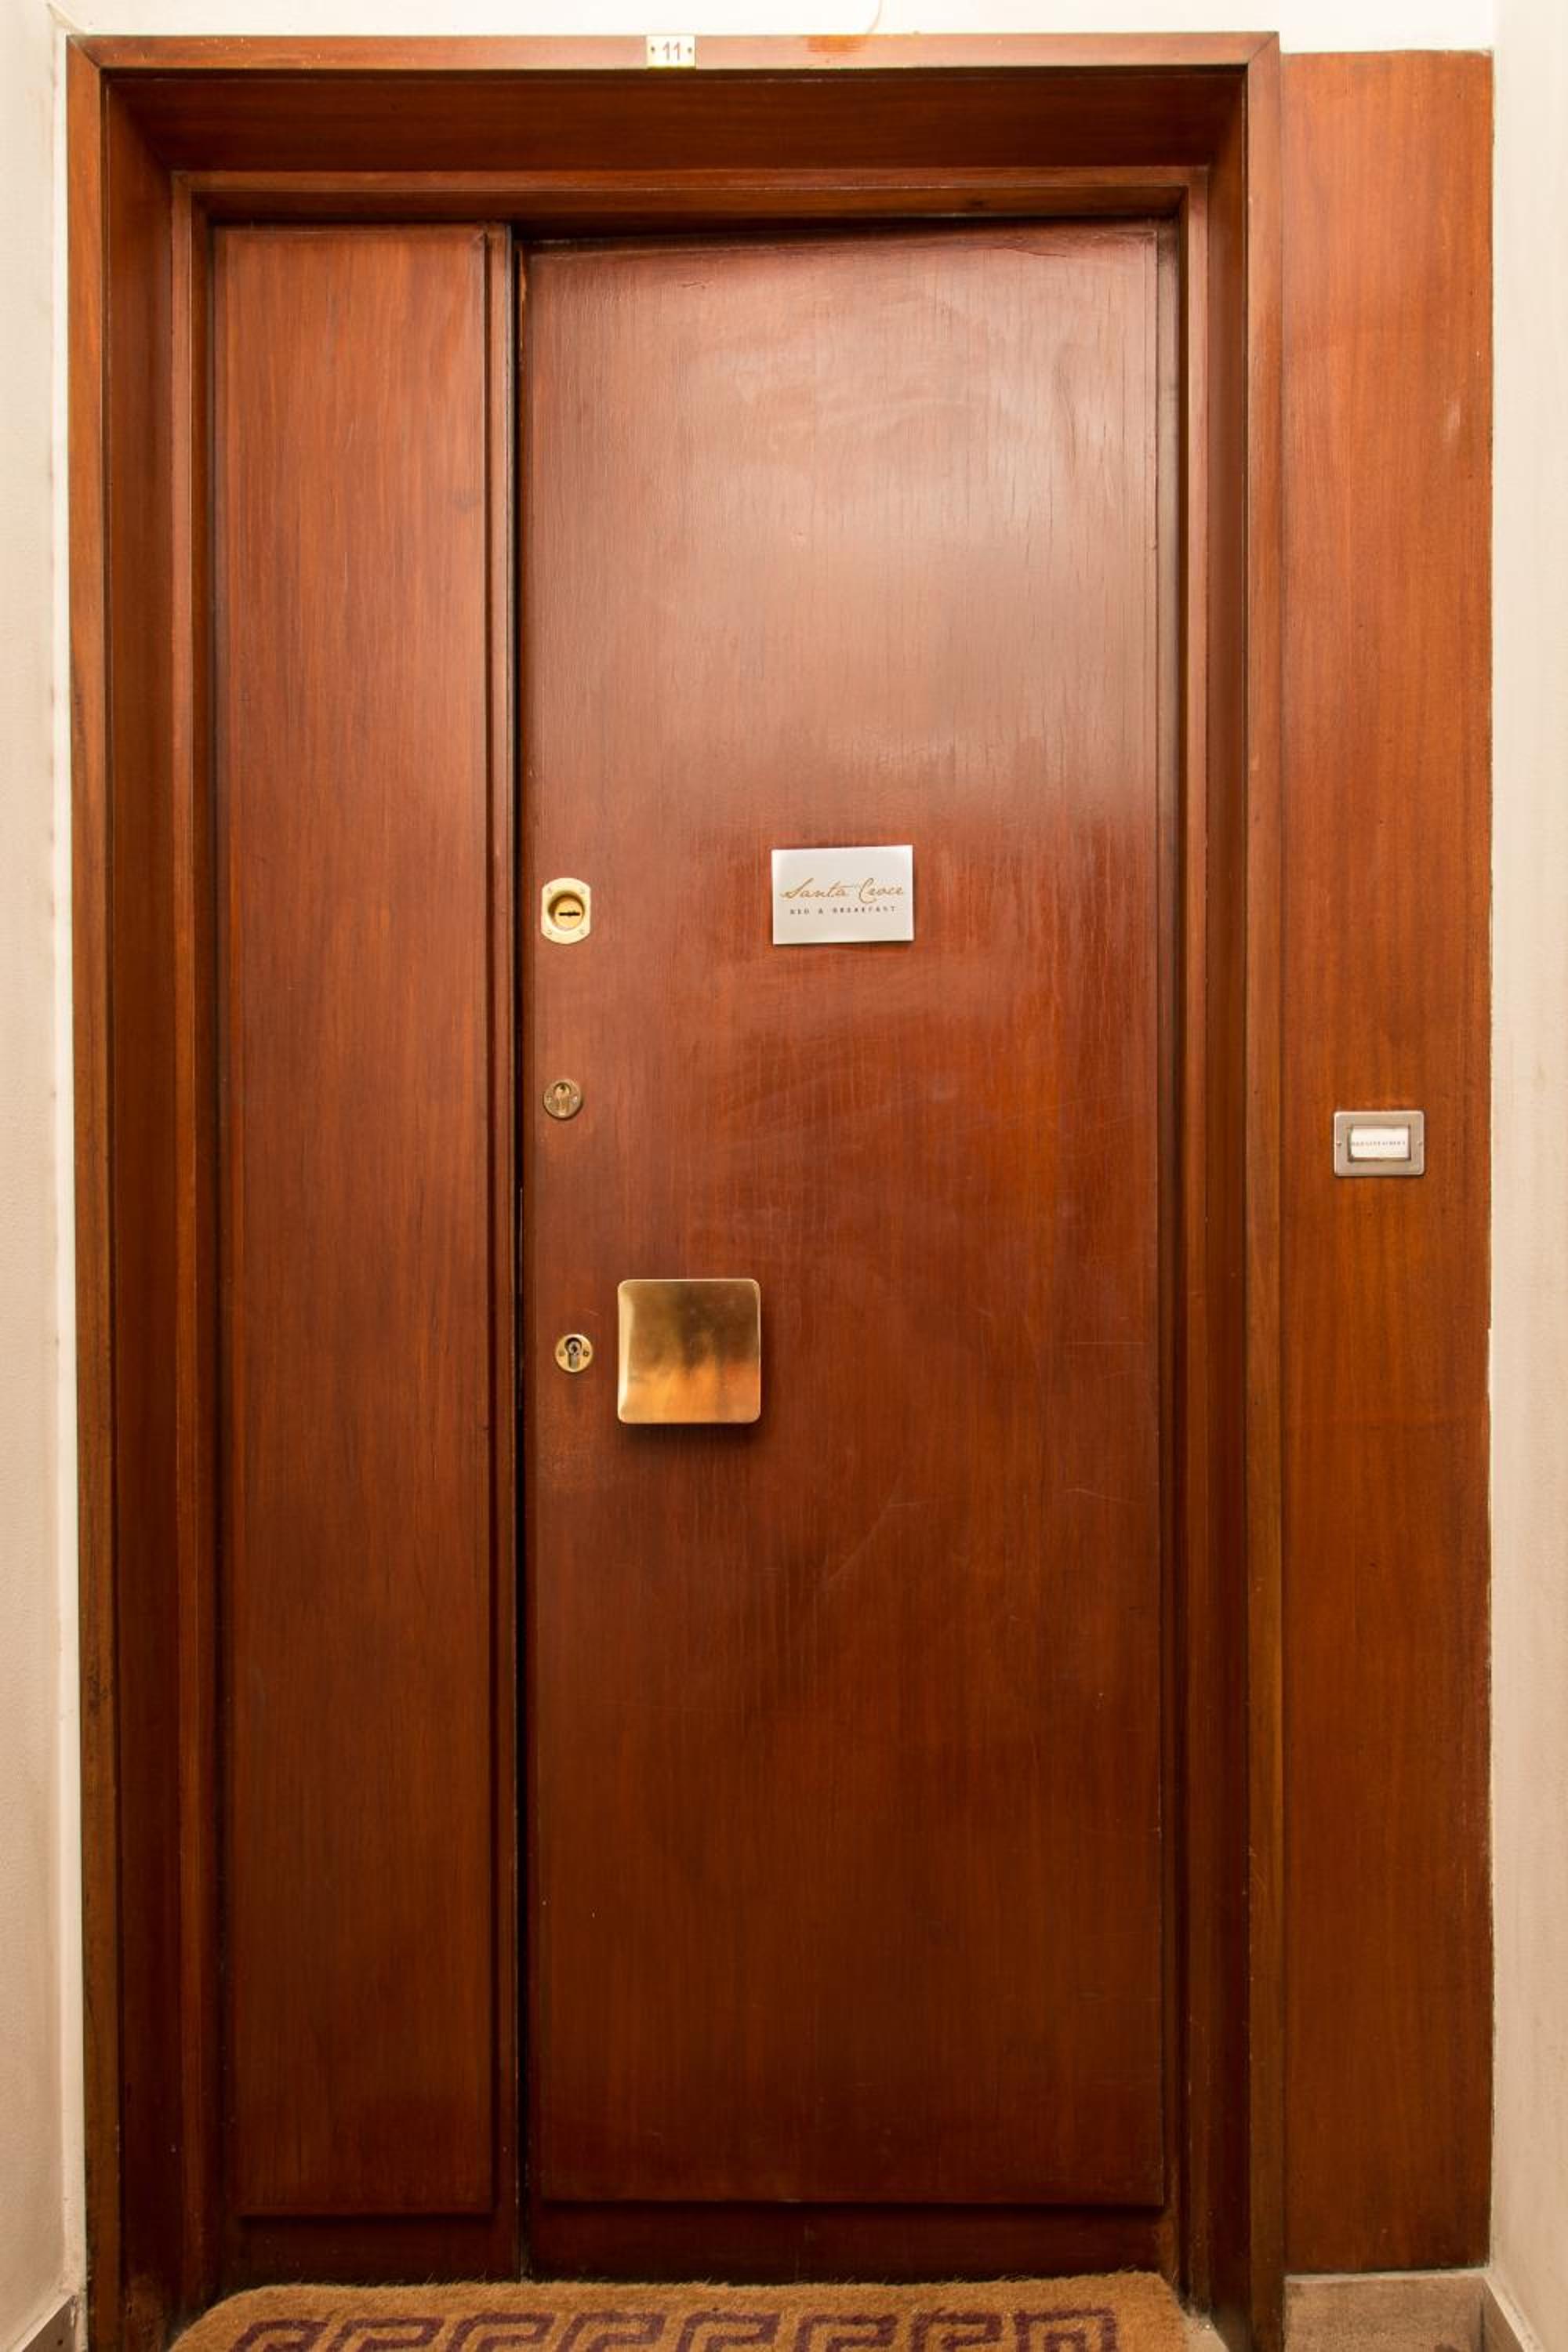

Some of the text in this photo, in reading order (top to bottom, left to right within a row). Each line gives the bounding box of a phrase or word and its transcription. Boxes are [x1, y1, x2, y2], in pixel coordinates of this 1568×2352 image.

[662, 41, 681, 60] 11
[779, 877, 904, 904] Santa Croce
